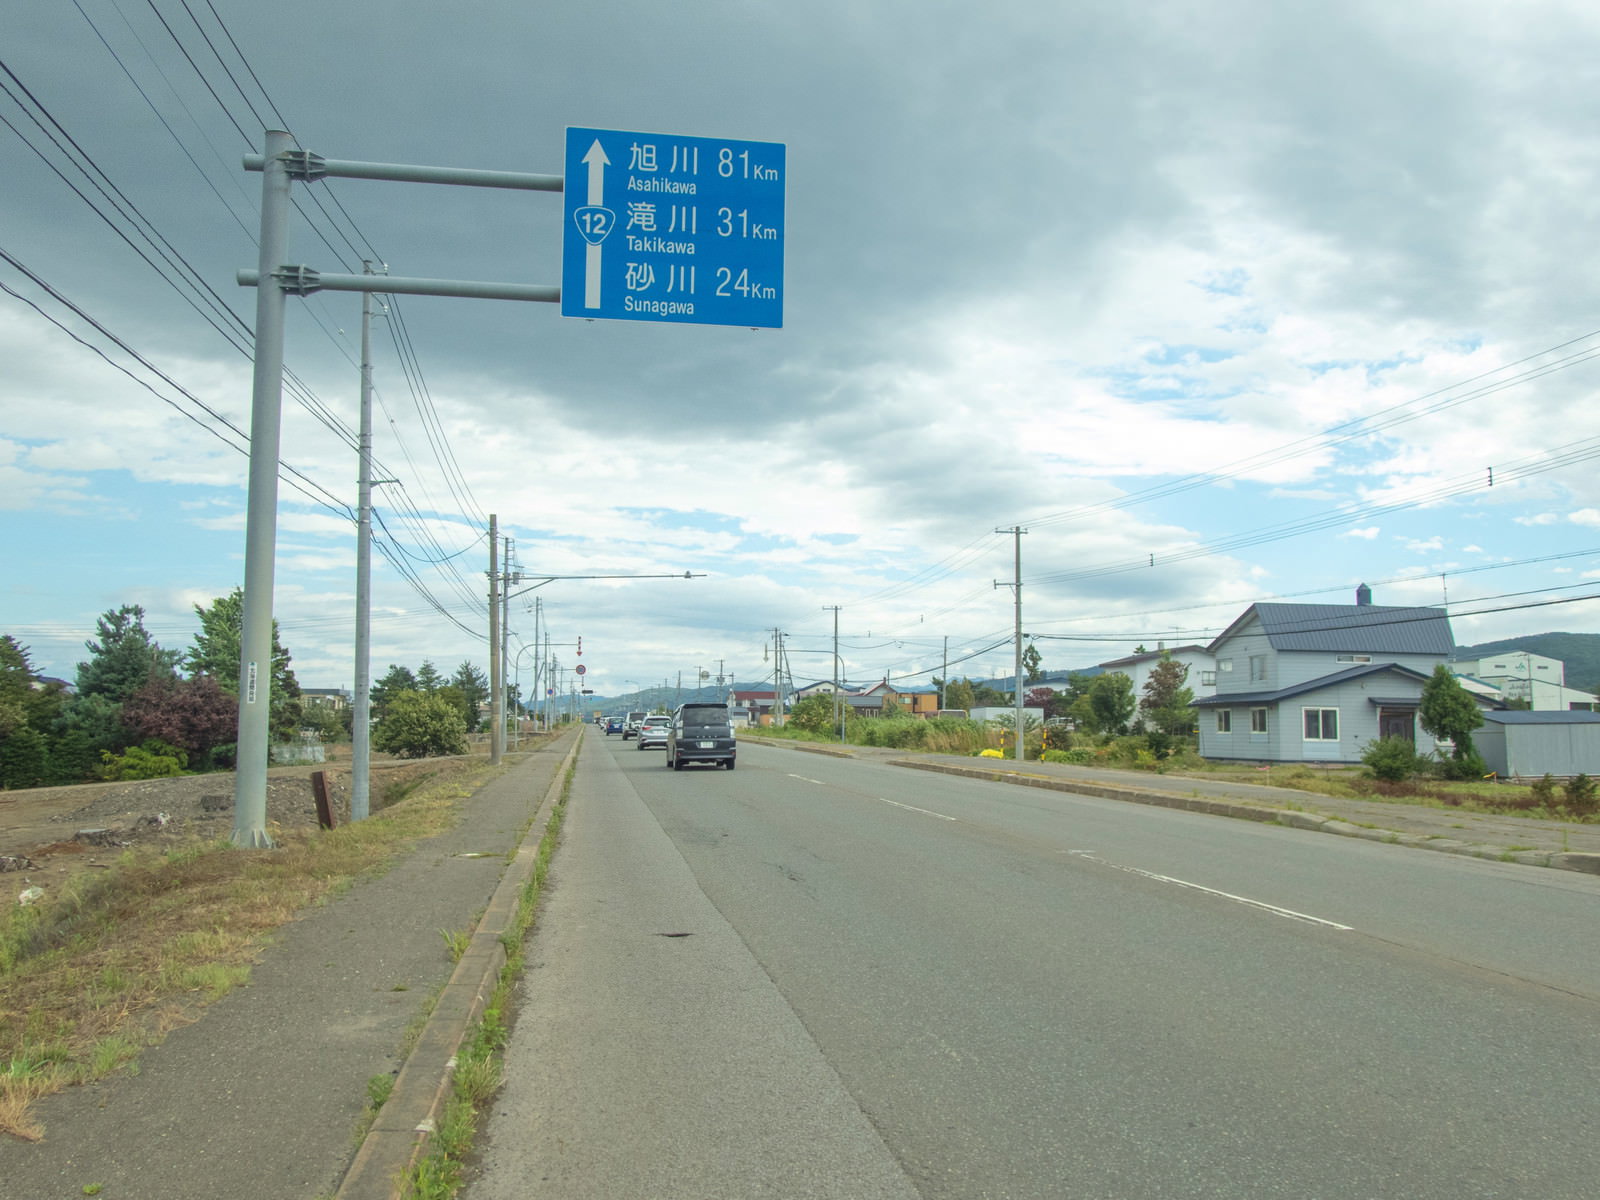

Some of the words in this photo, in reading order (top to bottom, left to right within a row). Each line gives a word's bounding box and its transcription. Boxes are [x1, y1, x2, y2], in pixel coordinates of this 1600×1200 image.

[628, 142, 698, 175] 旭川
[627, 175, 697, 195] Asahikawa
[581, 213, 606, 234] 12
[626, 202, 696, 234] 滝川
[626, 235, 695, 255] Takikawa
[625, 262, 695, 294] 砂川
[624, 295, 695, 316] Sunagawa
